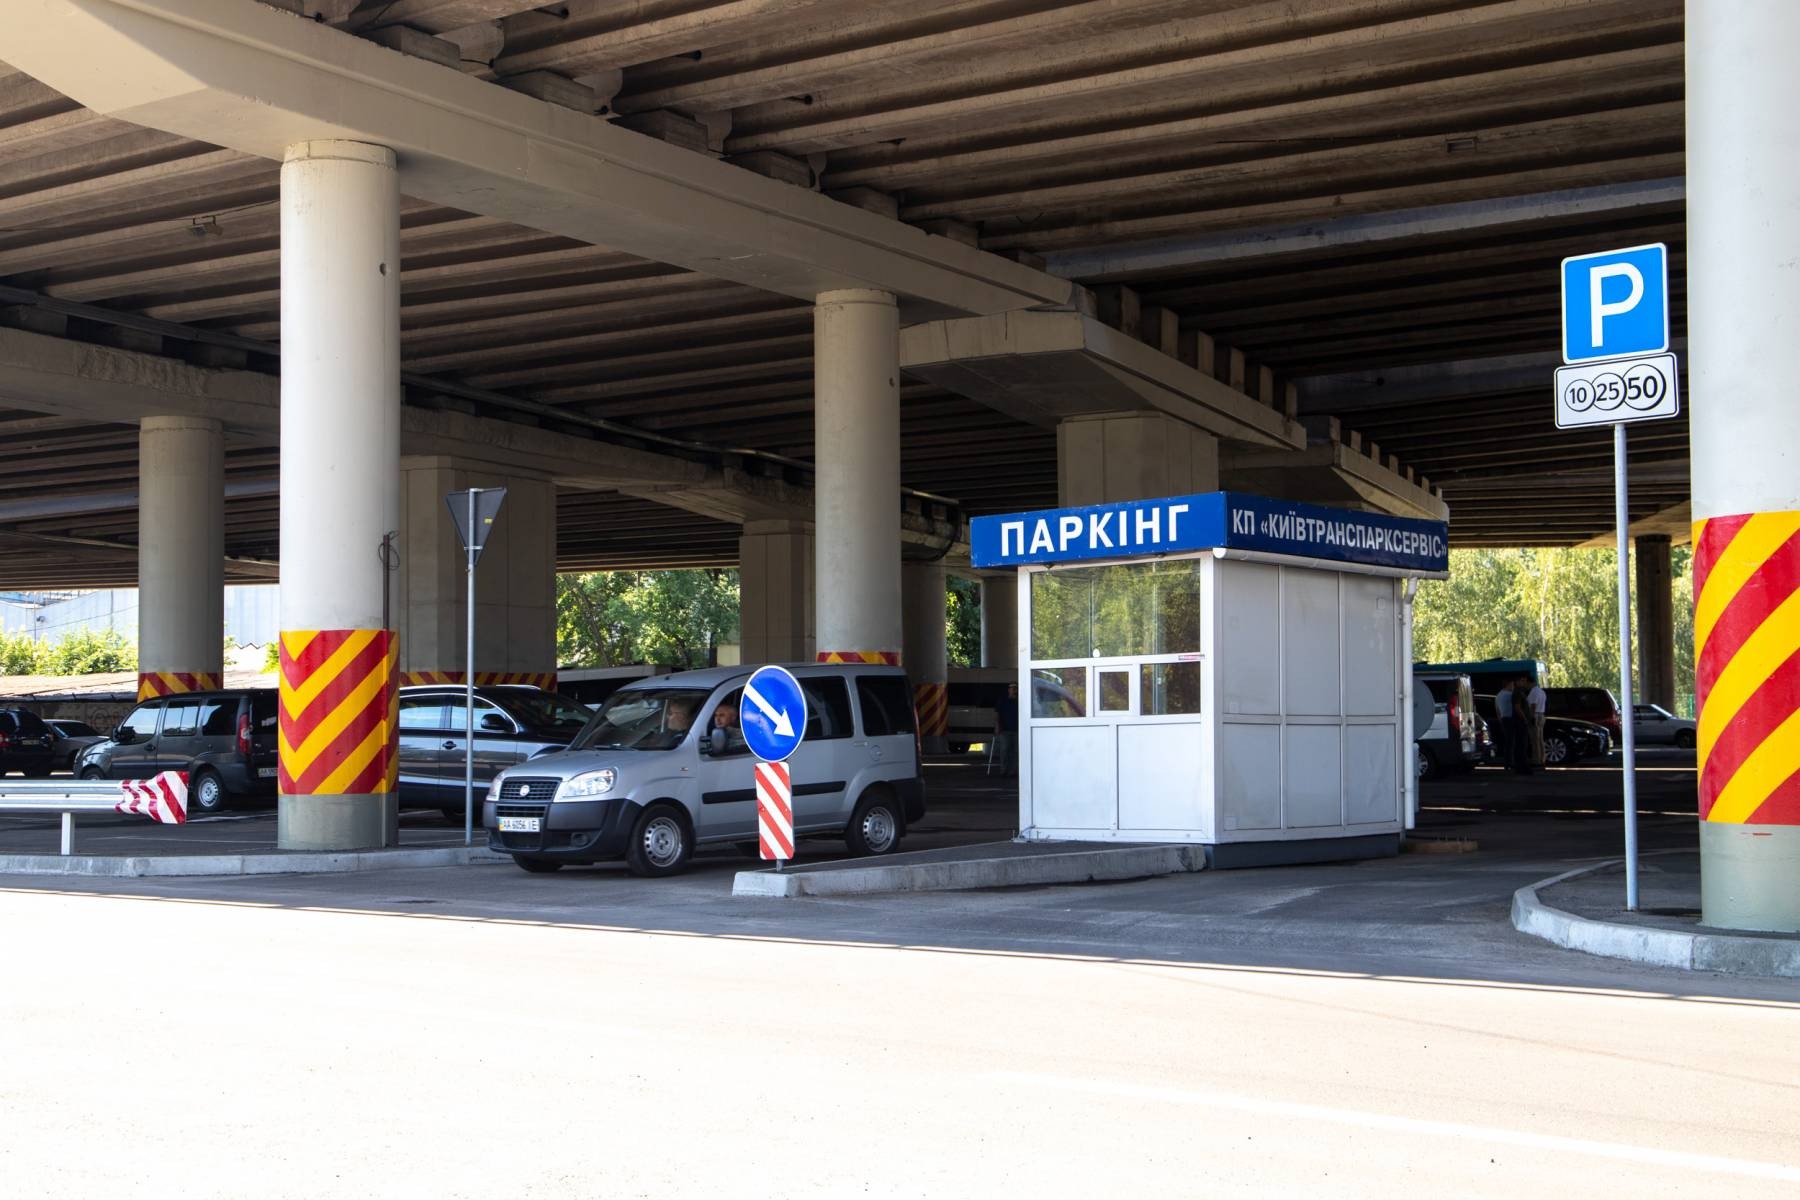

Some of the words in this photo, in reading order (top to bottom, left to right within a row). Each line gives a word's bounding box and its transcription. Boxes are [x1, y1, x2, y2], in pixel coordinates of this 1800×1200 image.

[1589, 262, 1644, 348] P
[1569, 387, 1587, 404] 10
[1596, 381, 1619, 402] 25
[1627, 375, 1658, 400] 50
[1000, 504, 1189, 557] ПАРКІНГ
[1232, 508, 1256, 535] КП
[1260, 512, 1447, 558] «КИЇВТРАНСПАРКСЕРВІС»
